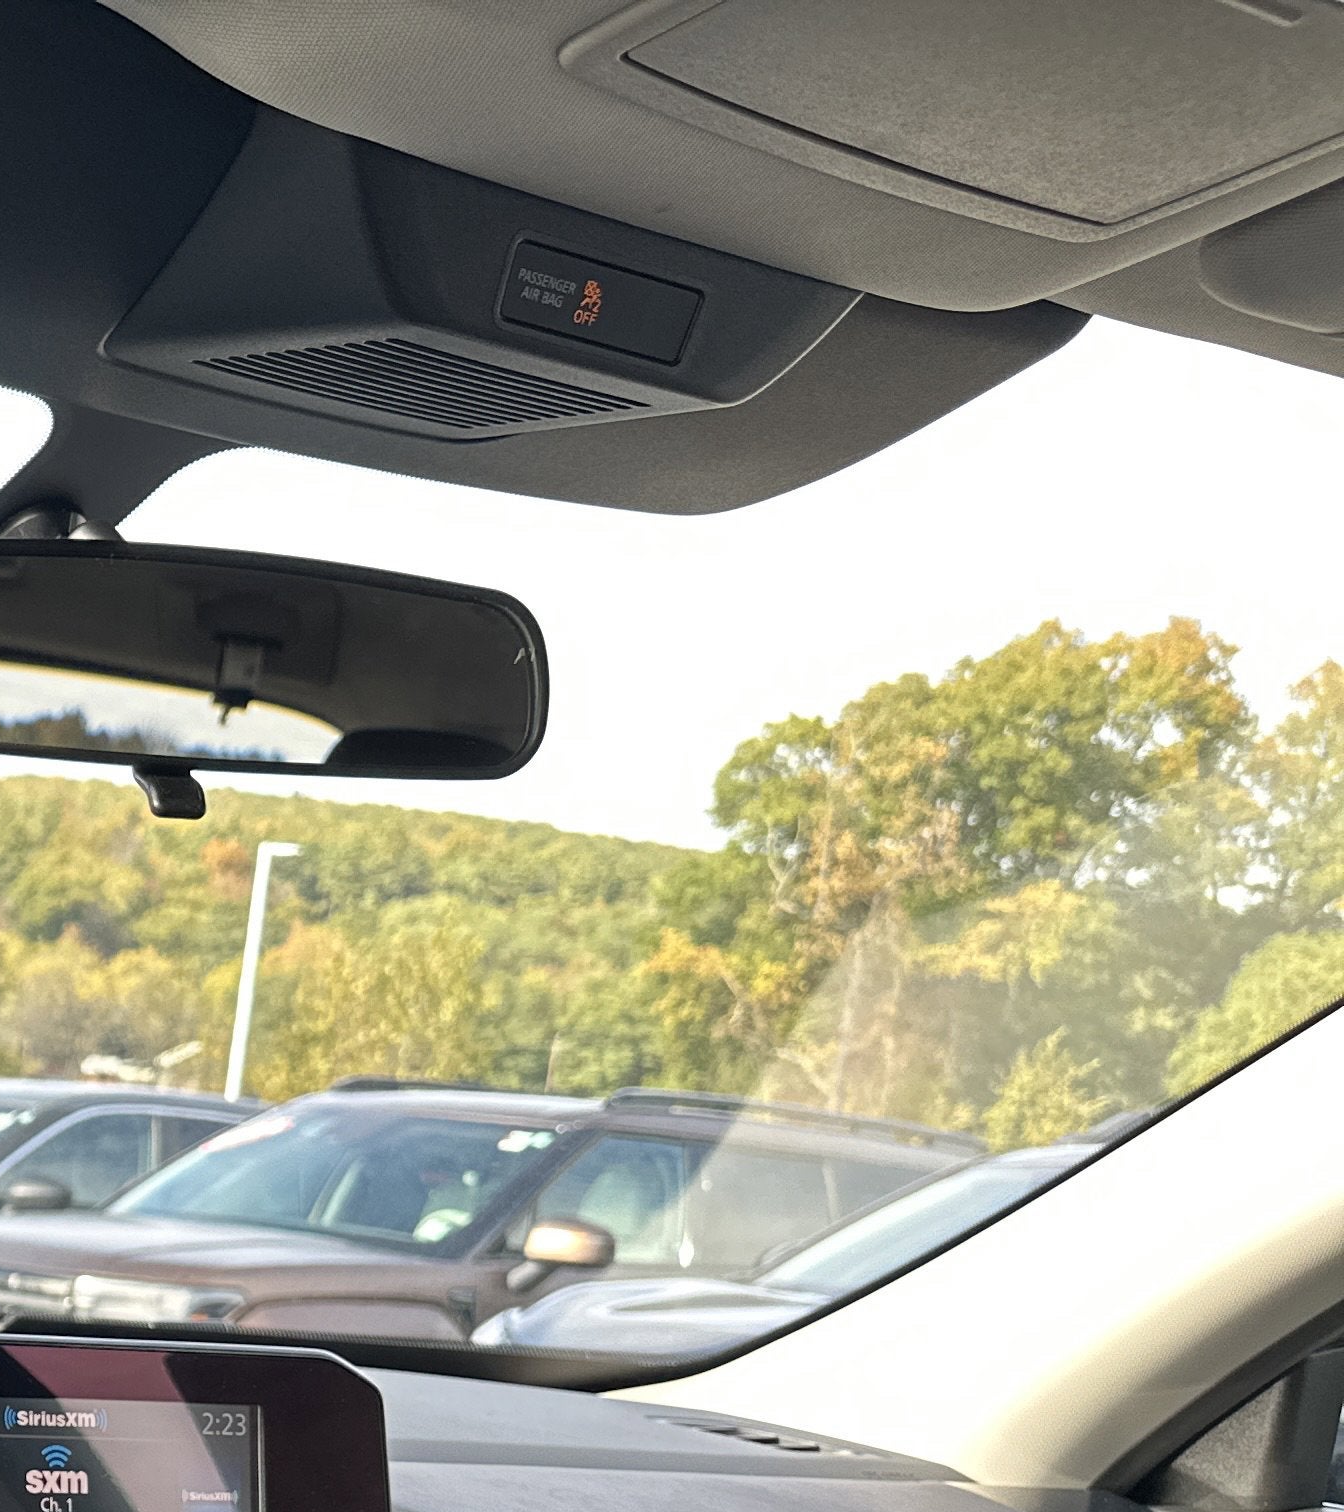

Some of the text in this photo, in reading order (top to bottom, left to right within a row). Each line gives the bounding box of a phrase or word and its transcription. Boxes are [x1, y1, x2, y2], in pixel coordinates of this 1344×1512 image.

[518, 268, 577, 295] PASSENGER
[520, 286, 565, 308] AIR BAG
[573, 309, 599, 327] OFF
[201, 1412, 248, 1437] 2:23
[25, 1469, 89, 1495] sxm
[40, 1497, 73, 1512] Ch. 1
